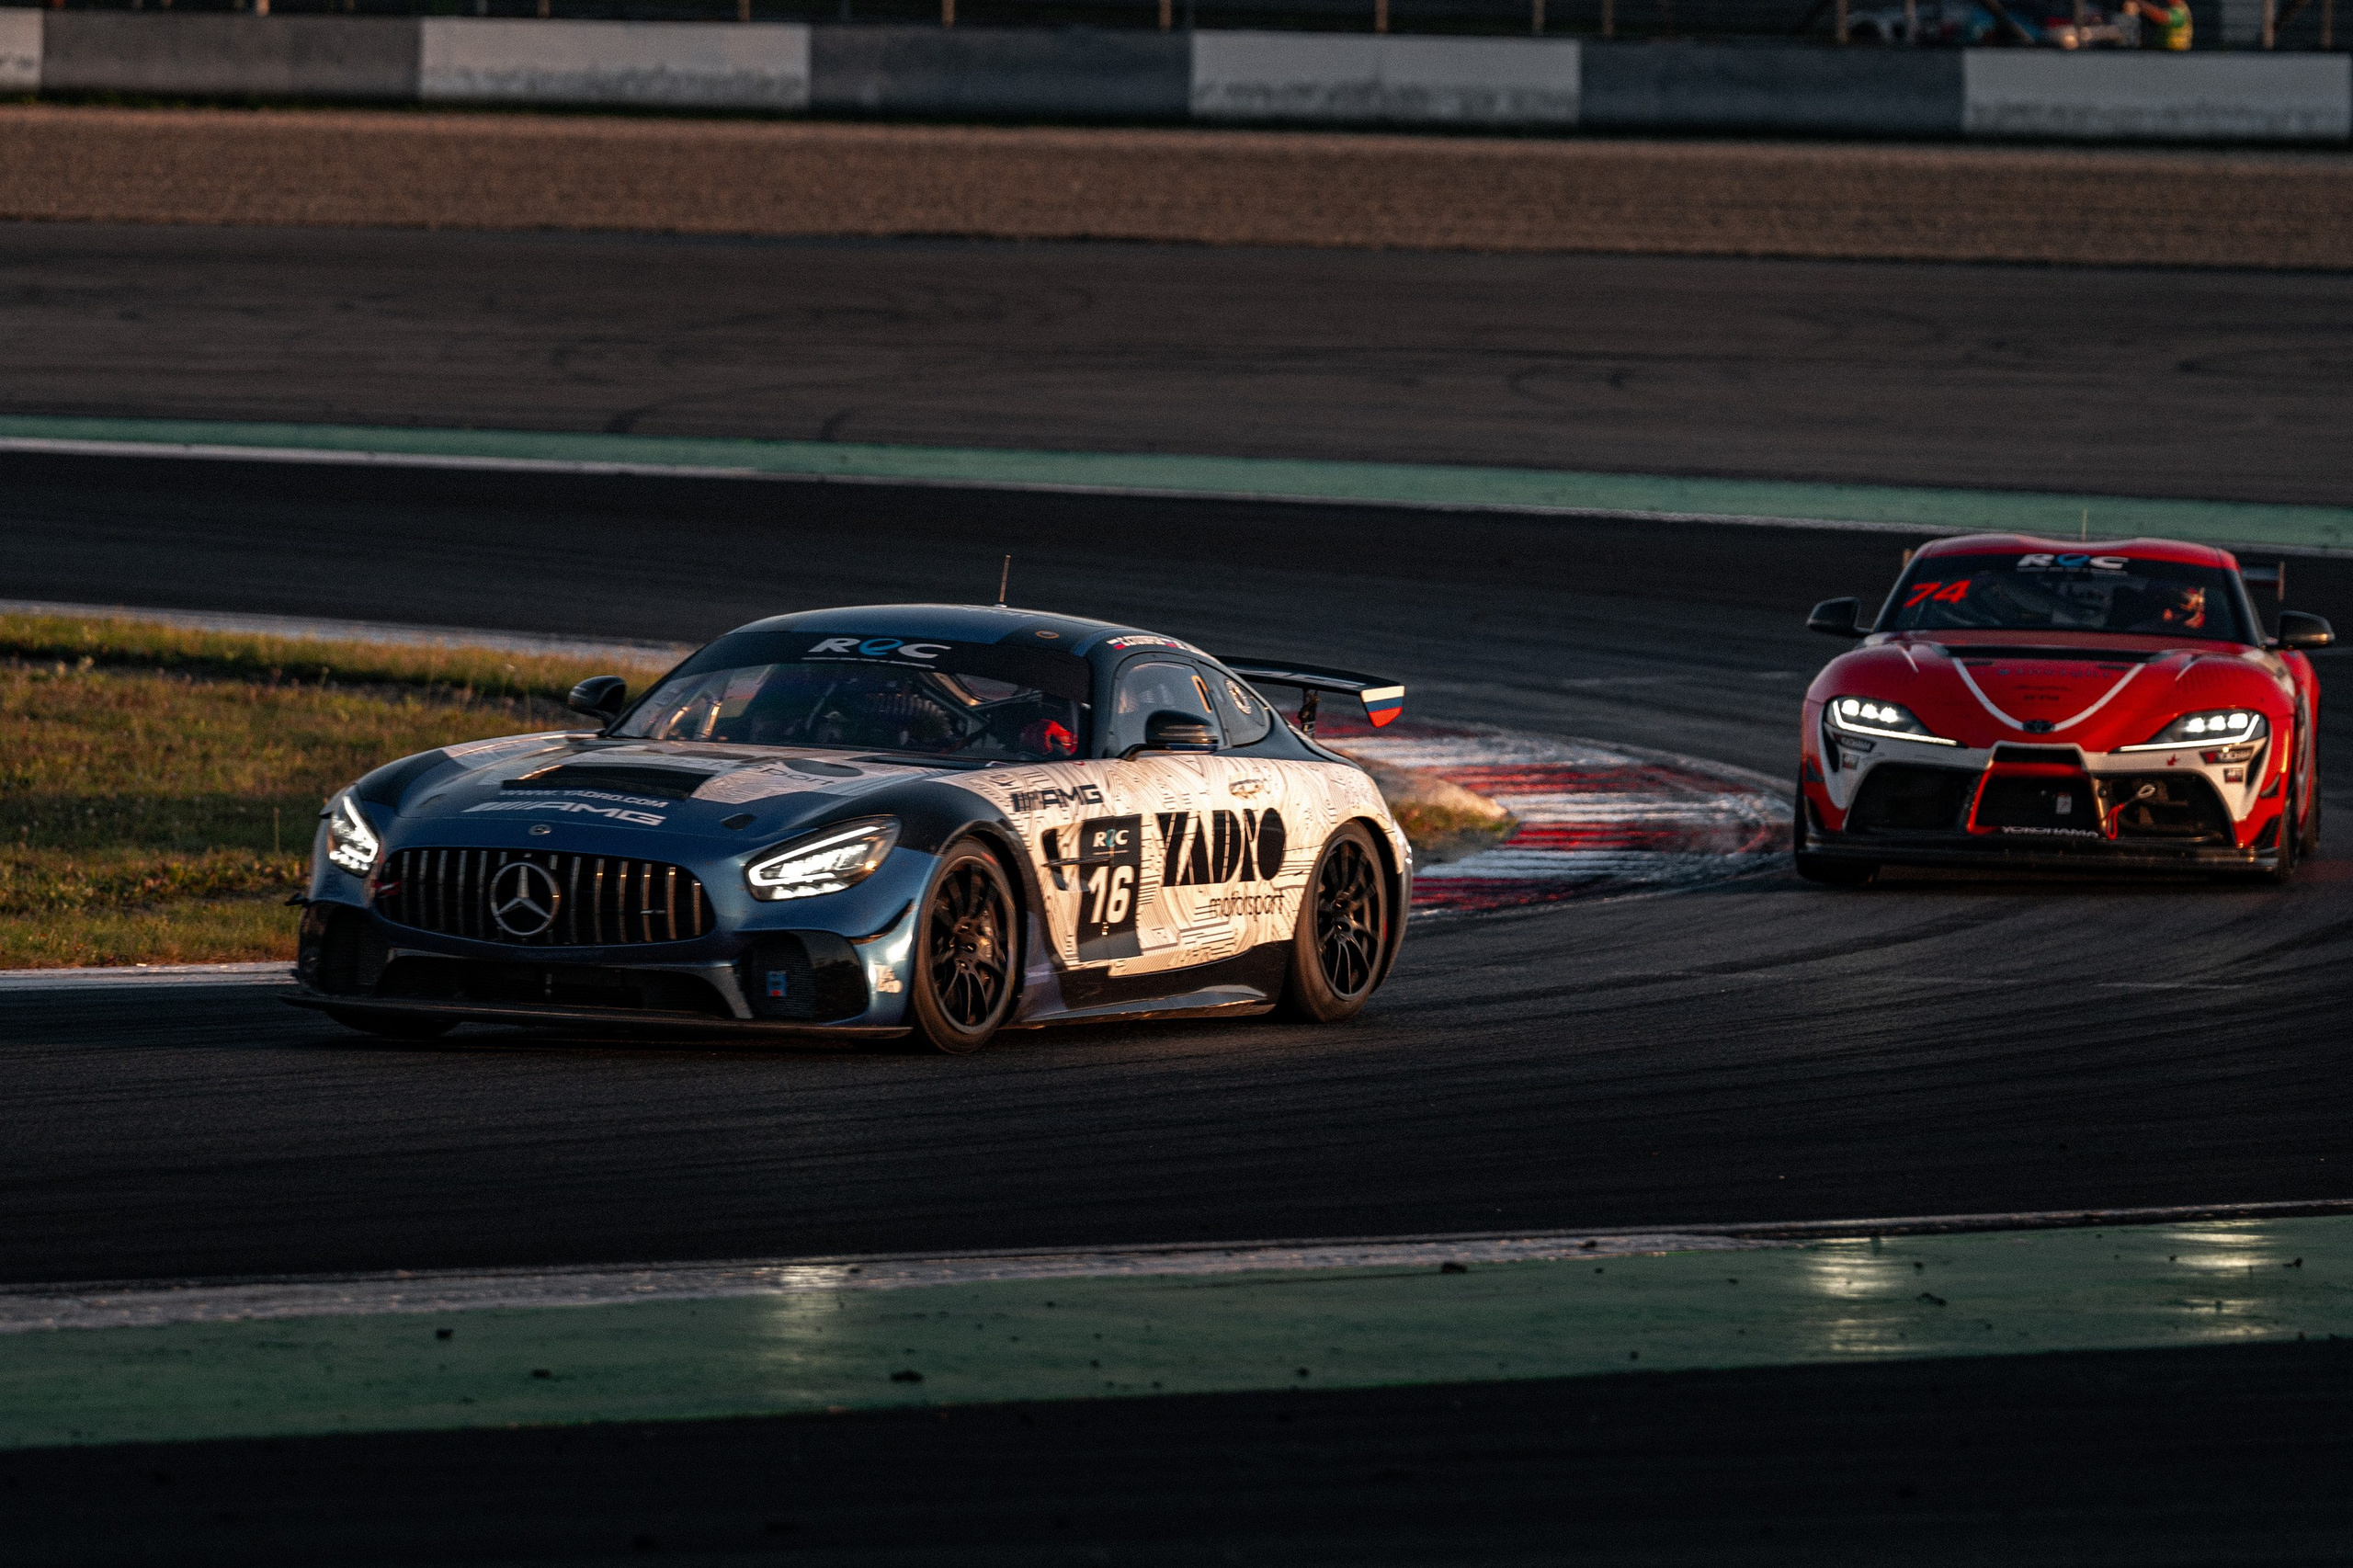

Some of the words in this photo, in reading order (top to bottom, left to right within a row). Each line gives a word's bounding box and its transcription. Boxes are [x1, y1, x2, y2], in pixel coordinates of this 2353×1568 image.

[1904, 580, 1972, 608] 74
[2000, 824, 2099, 838] YOKOHAMA
[1087, 865, 1135, 925] 16
